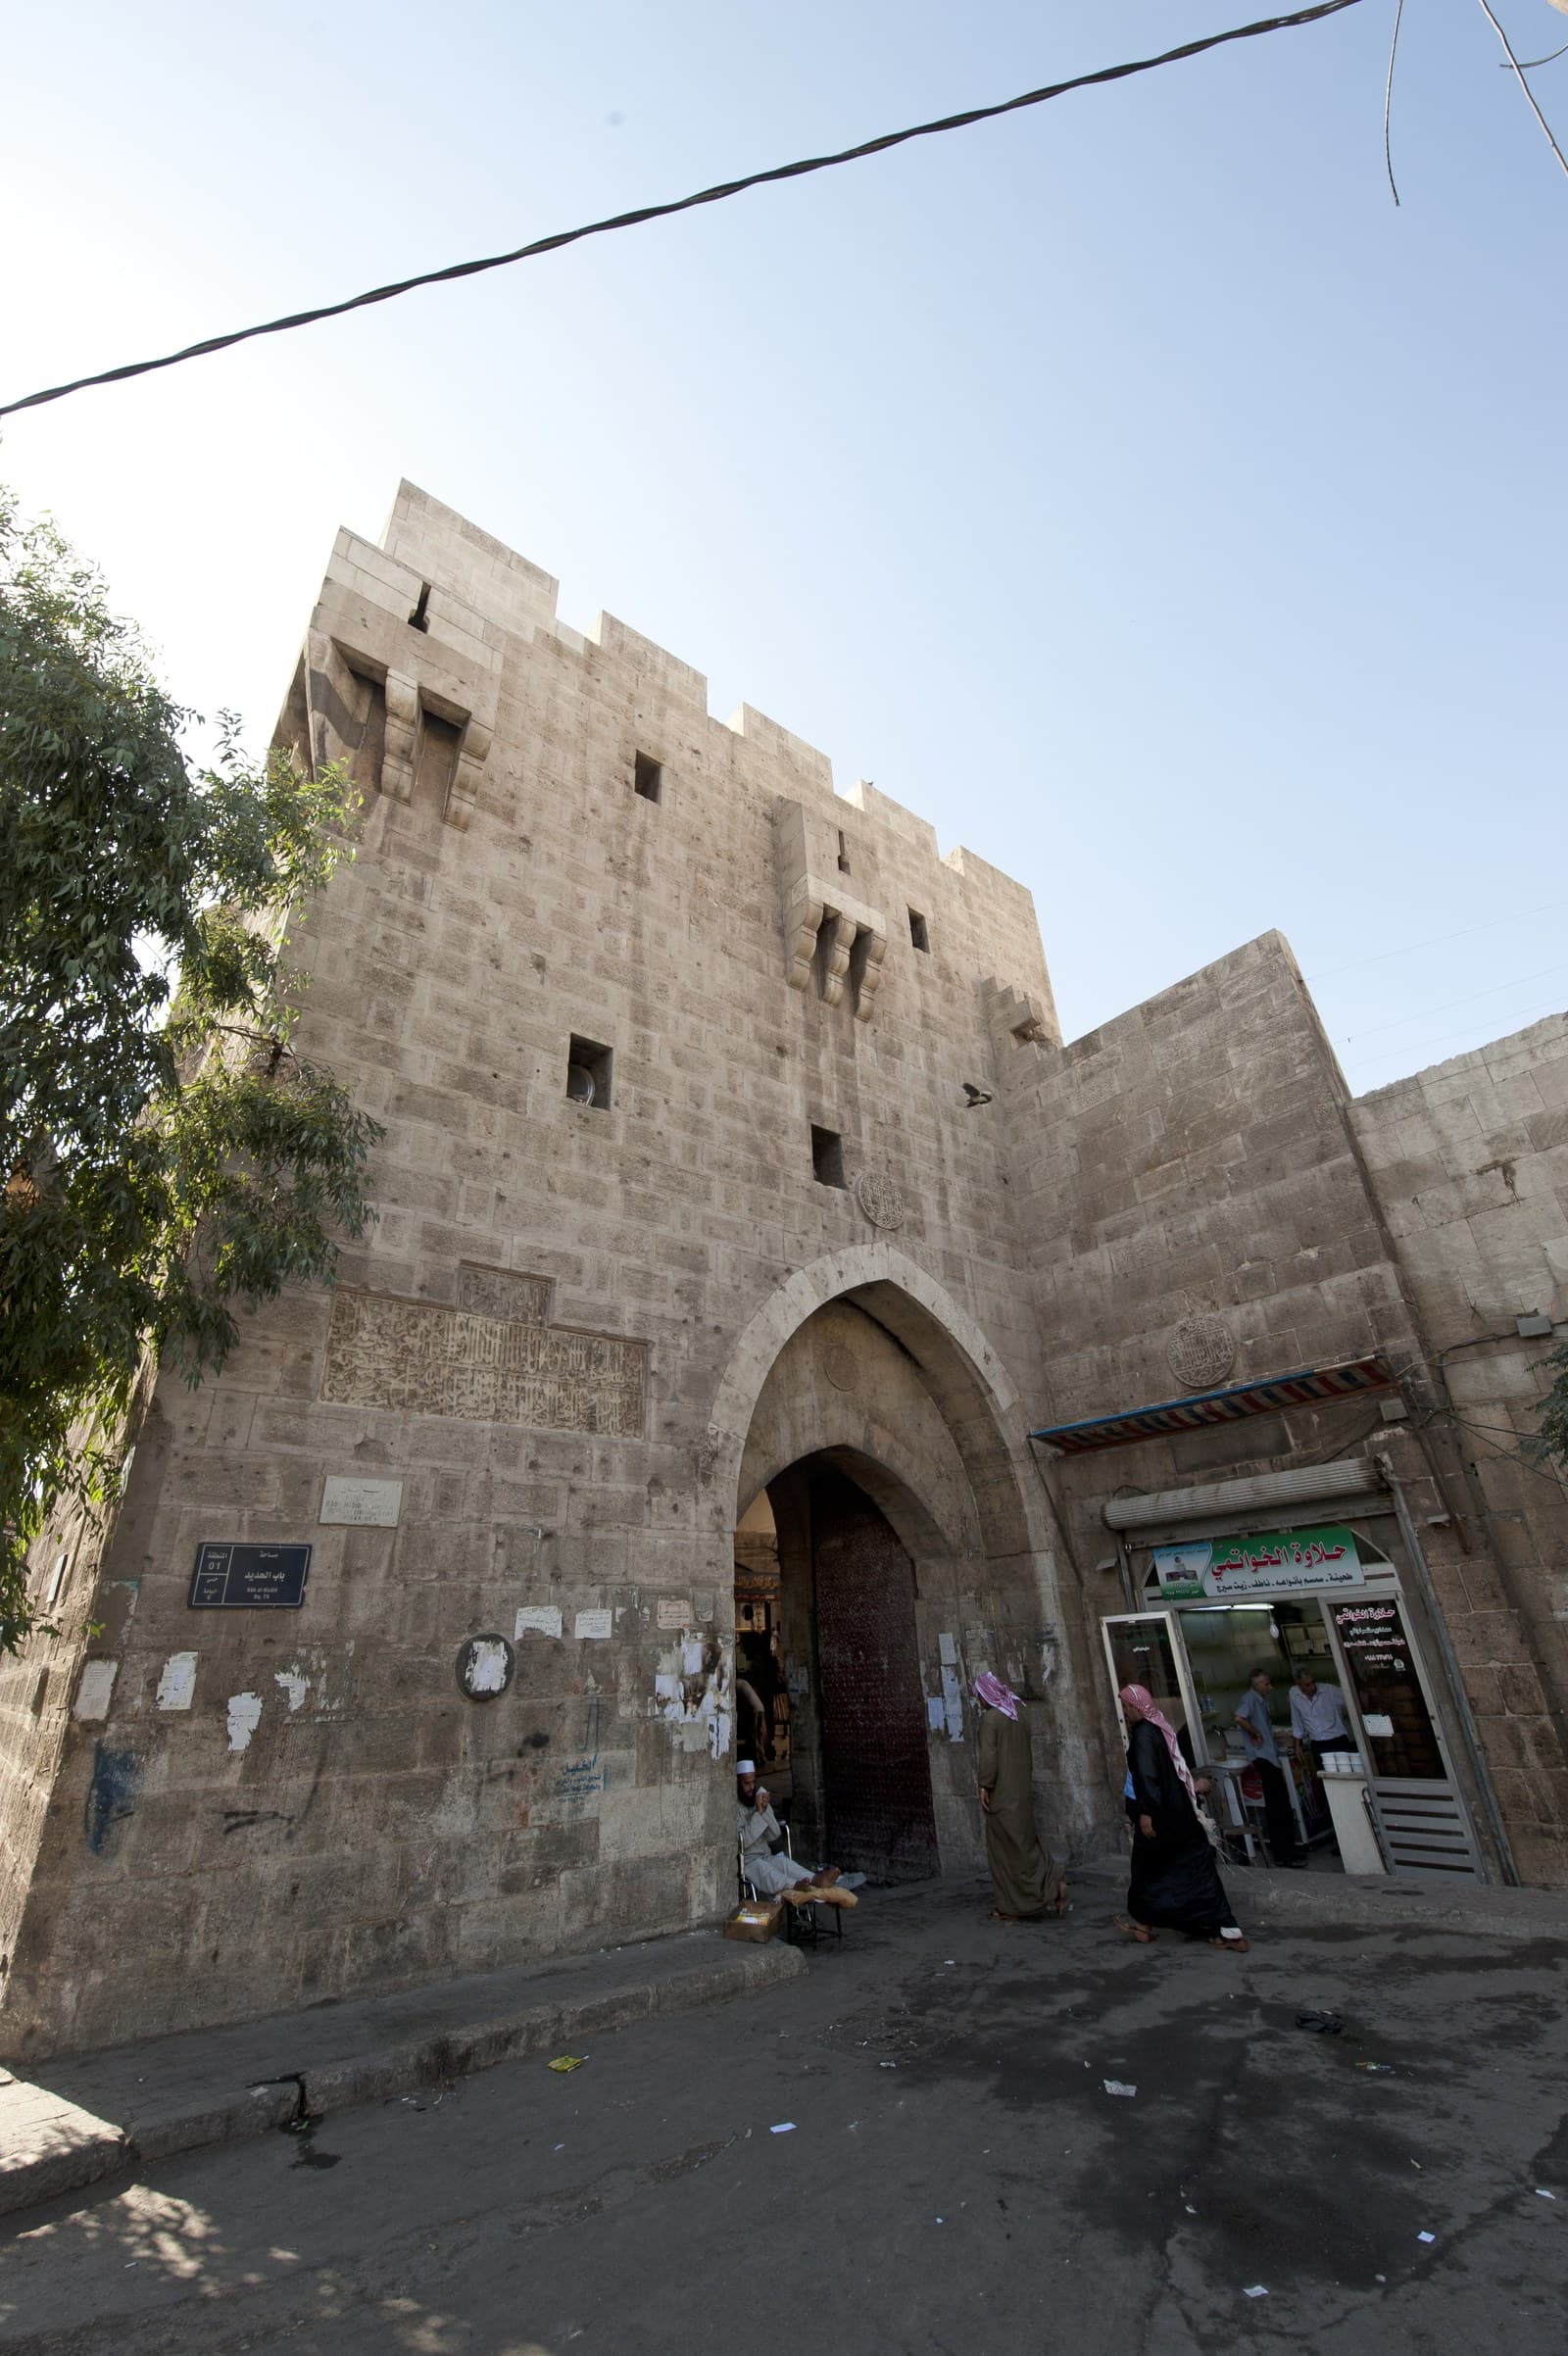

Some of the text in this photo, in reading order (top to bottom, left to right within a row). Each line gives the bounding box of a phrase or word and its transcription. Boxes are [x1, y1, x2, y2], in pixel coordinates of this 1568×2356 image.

[208, 1561, 220, 1570] 01
[1211, 1541, 1348, 1582] حلاوة الخواتمي
[244, 1571, 285, 1582] باب الحديد
